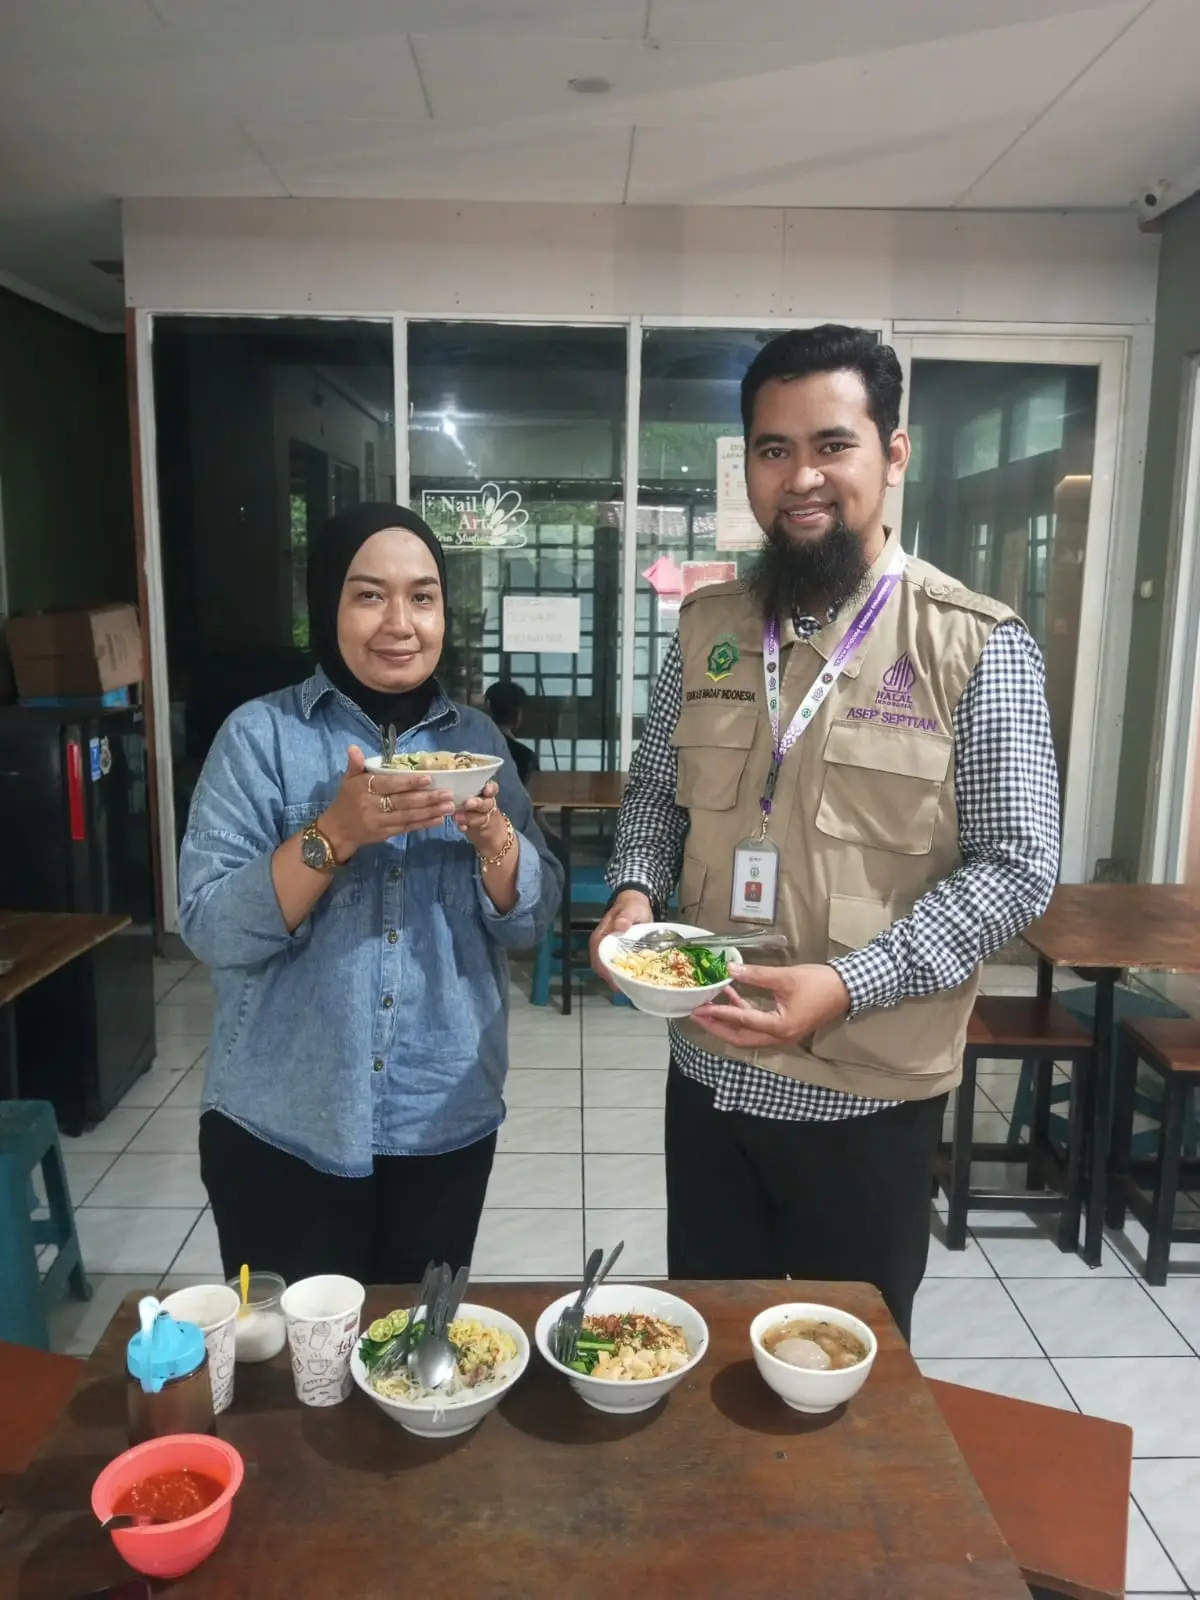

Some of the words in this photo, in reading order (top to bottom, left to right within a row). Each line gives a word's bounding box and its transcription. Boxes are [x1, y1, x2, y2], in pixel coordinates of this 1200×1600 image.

[440, 495, 477, 513] Nail
[458, 513, 487, 530] Art
[721, 688, 756, 703] INDONESIA
[876, 690, 913, 704] HALAL
[847, 706, 879, 720] ASEP
[881, 710, 938, 731] SEPTIAN
